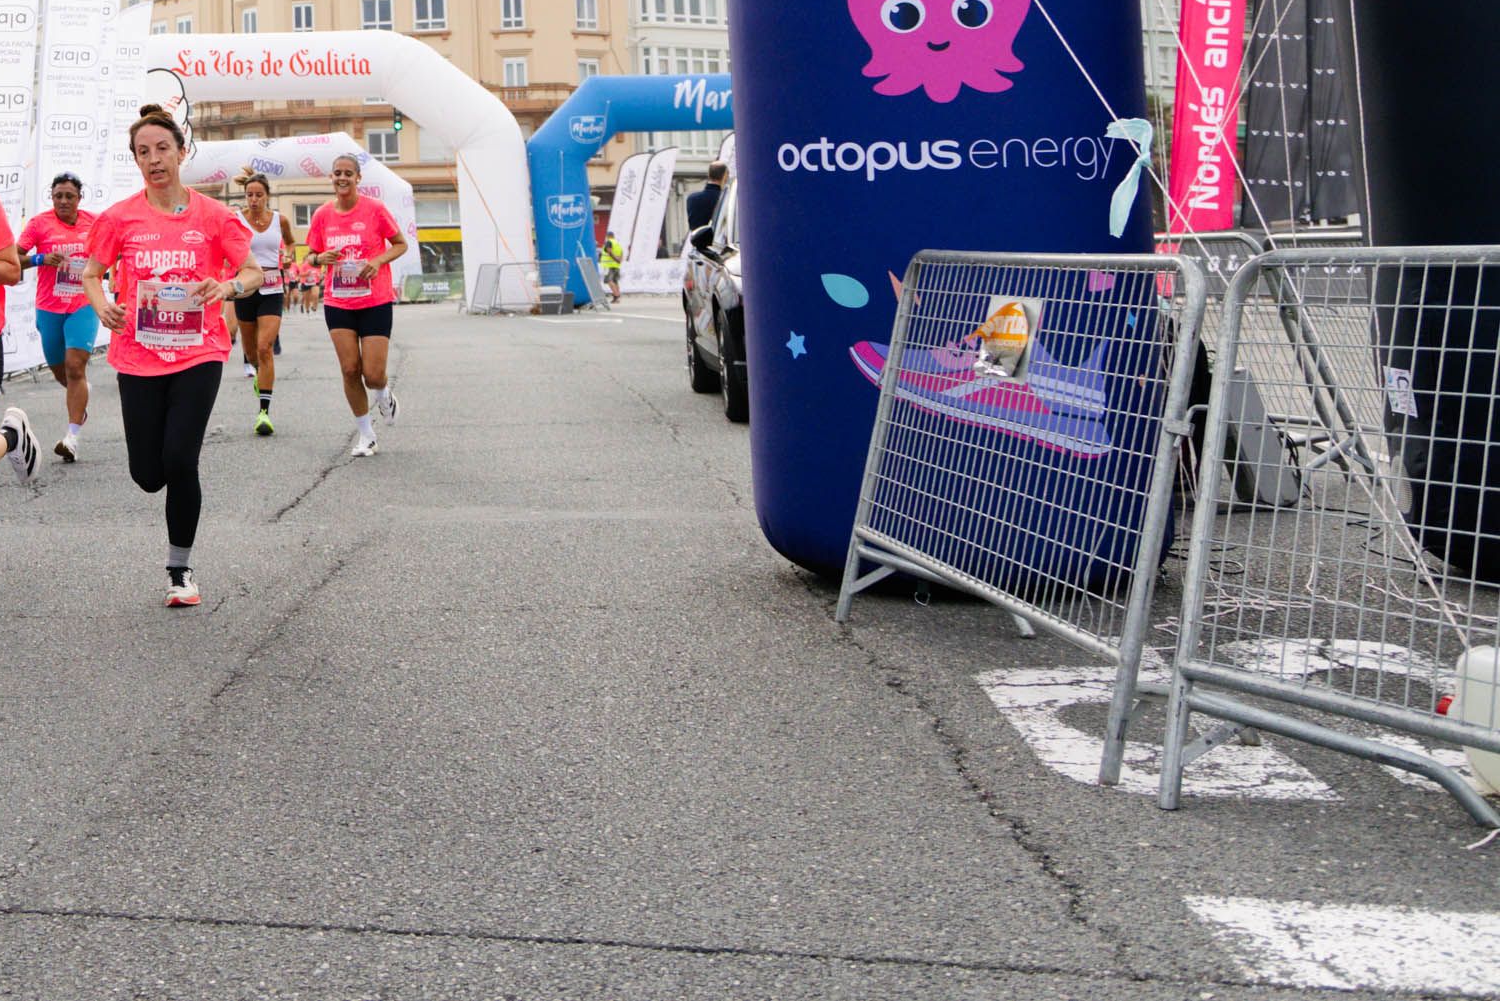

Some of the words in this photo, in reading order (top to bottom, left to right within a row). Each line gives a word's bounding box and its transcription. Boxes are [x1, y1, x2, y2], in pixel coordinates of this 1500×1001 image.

[53, 50, 90, 64] ziaja
[116, 47, 140, 57] iaja
[171, 50, 207, 77] La
[209, 50, 254, 81] Voz
[260, 50, 283, 77] de
[290, 49, 371, 77] Galicia
[114, 99, 138, 110] iaja
[51, 120, 88, 134] ziaja
[1251, 130, 1304, 138] VOLVO
[1188, 87, 1224, 210] Nordés
[778, 137, 962, 181] octopus
[969, 136, 1114, 180] energy
[251, 158, 285, 177] COSMO
[135, 250, 196, 269] CARRERA
[158, 311, 185, 322] 016
